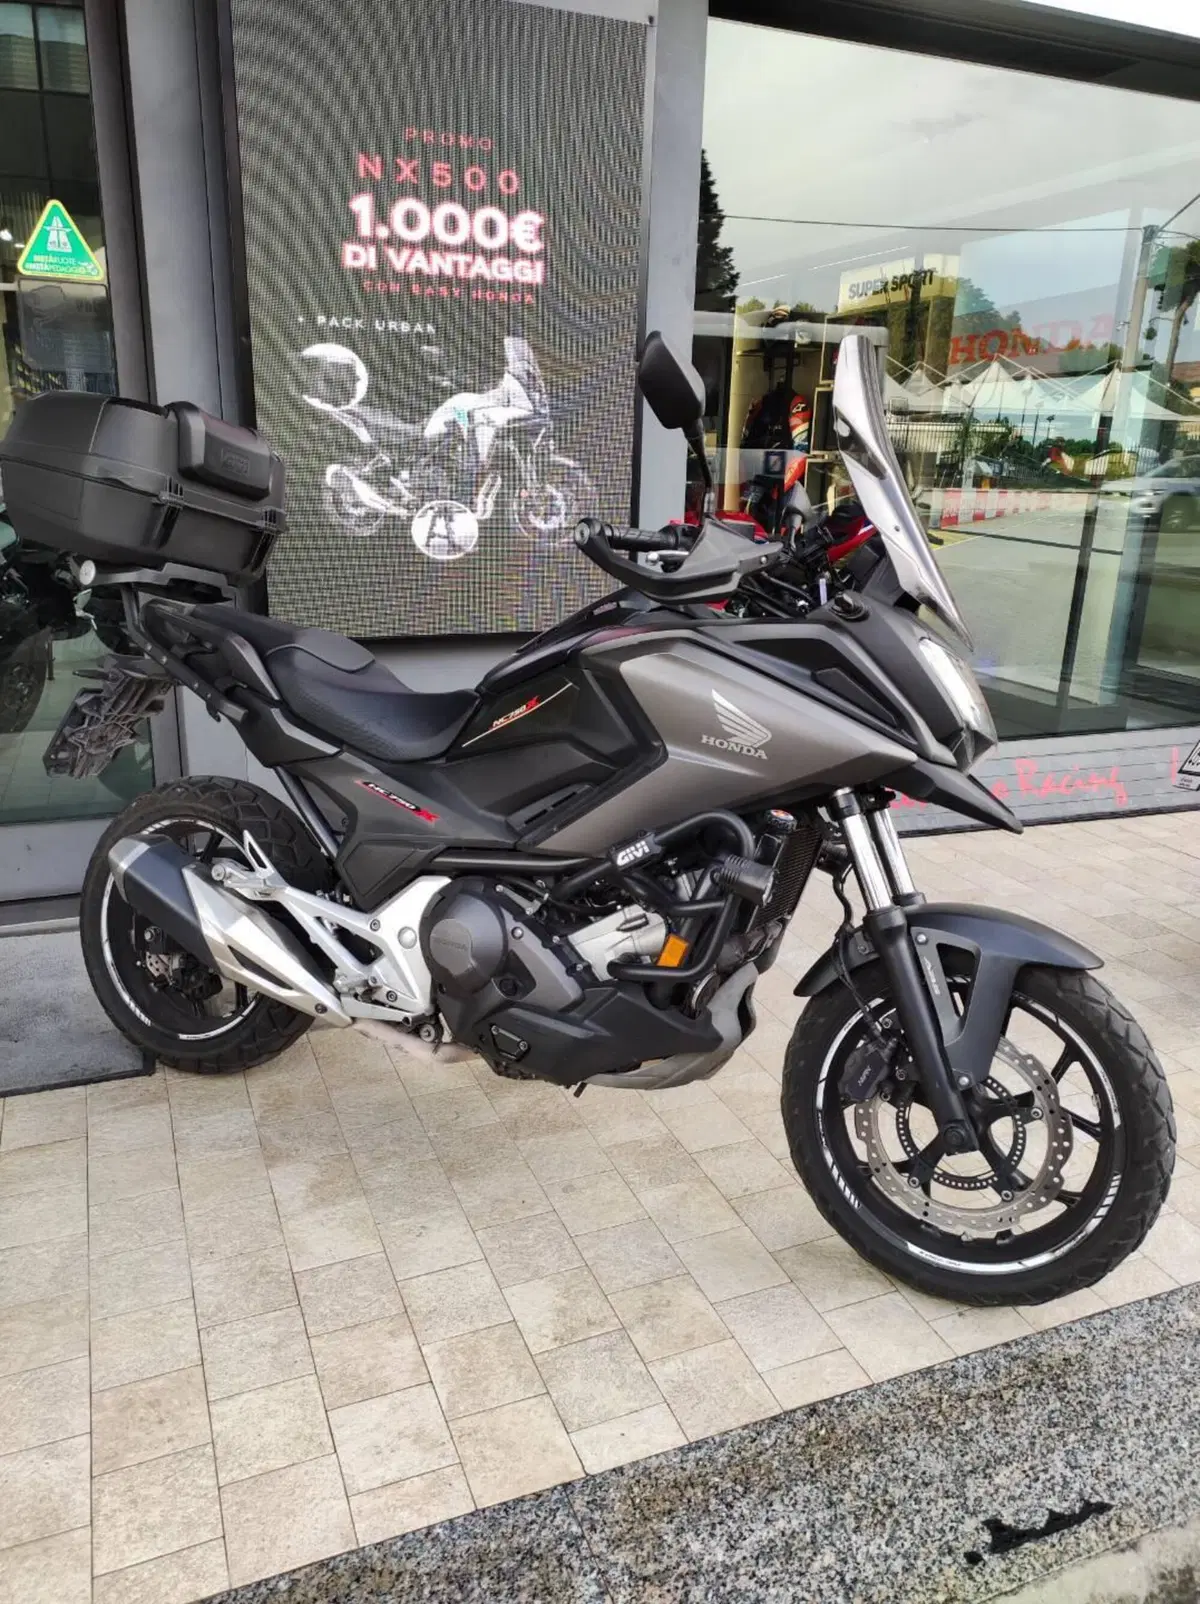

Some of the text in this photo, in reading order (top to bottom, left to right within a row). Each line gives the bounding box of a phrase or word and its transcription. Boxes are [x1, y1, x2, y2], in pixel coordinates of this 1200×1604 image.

[403, 126, 494, 152] PROMO
[357, 152, 520, 195] NX500
[349, 192, 545, 253] 1.000€
[343, 242, 545, 284] DI VANTAGGI
[848, 278, 889, 299] SUPER
[317, 315, 364, 329] PACK
[375, 319, 437, 335] URBAN
[949, 314, 1114, 365] HONDA
[701, 733, 768, 760] HONDA
[1015, 757, 1128, 806] Racing
[616, 840, 650, 867] GIVI
